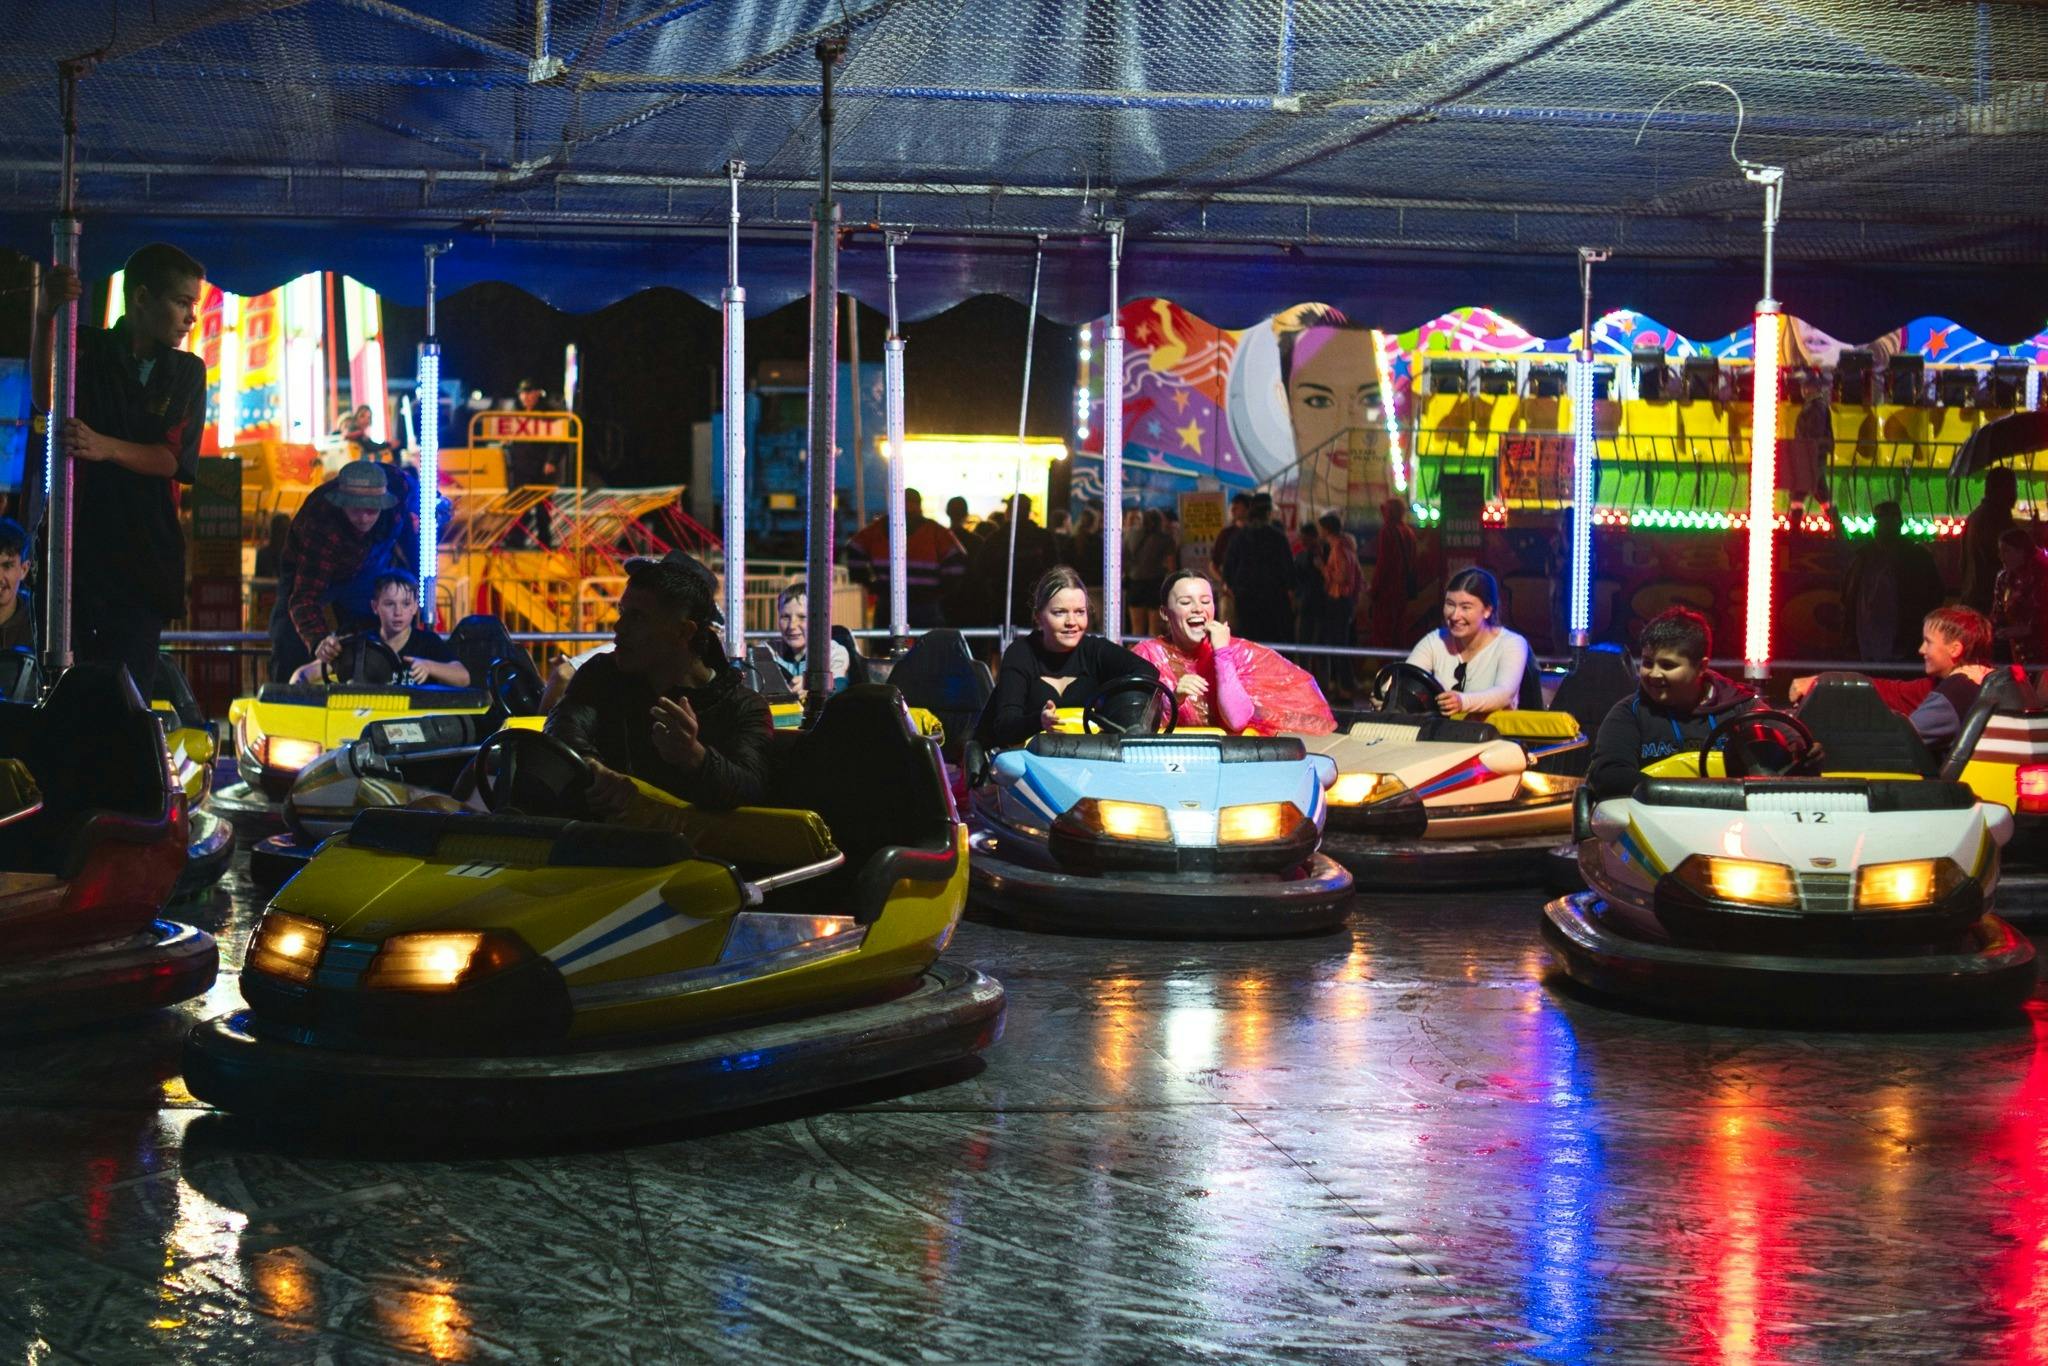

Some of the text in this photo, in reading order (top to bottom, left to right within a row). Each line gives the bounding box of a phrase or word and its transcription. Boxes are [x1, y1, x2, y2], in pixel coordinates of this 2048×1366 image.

[498, 416, 556, 436] EXIT
[1168, 763, 1182, 773] 2
[1791, 811, 1828, 824] 12
